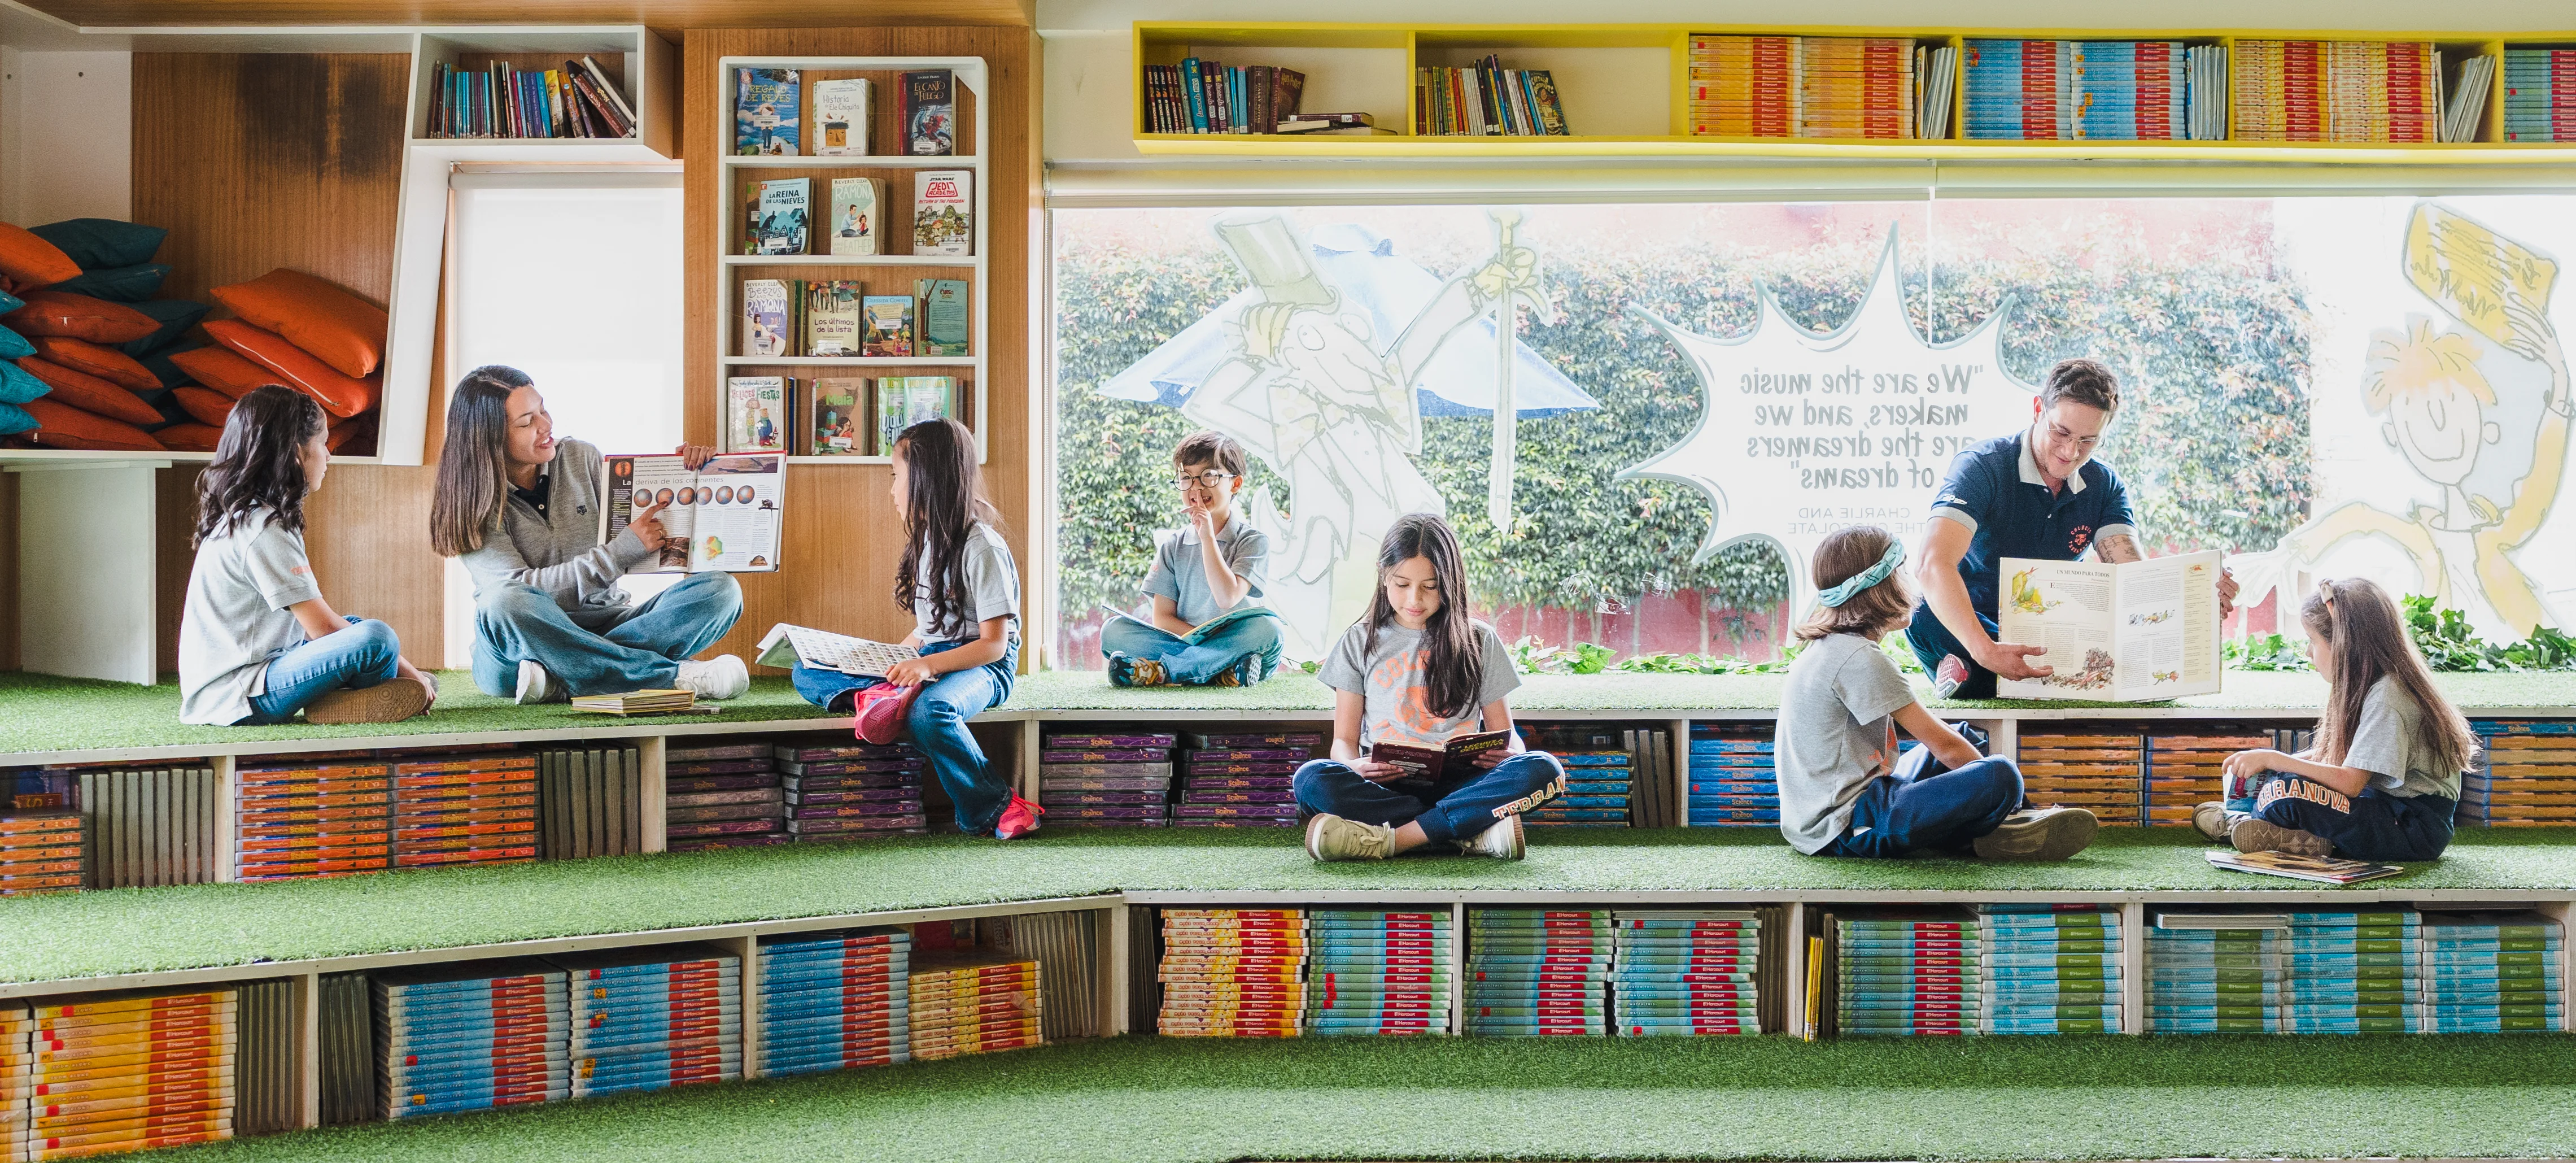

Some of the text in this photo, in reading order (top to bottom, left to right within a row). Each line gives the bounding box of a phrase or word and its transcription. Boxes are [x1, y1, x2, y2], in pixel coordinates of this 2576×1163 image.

[749, 85, 787, 93] REGALO
[762, 94, 791, 102] REYES
[823, 95, 849, 103] Historia
[836, 185, 873, 201] RAMONA
[757, 387, 780, 400] FIESTAS
[1374, 650, 1430, 689] COLE
[1091, 738, 1112, 746] Science
[1731, 785, 1753, 793] Science
[2258, 779, 2350, 814] ERRANOVA
[290, 825, 316, 833] Science
